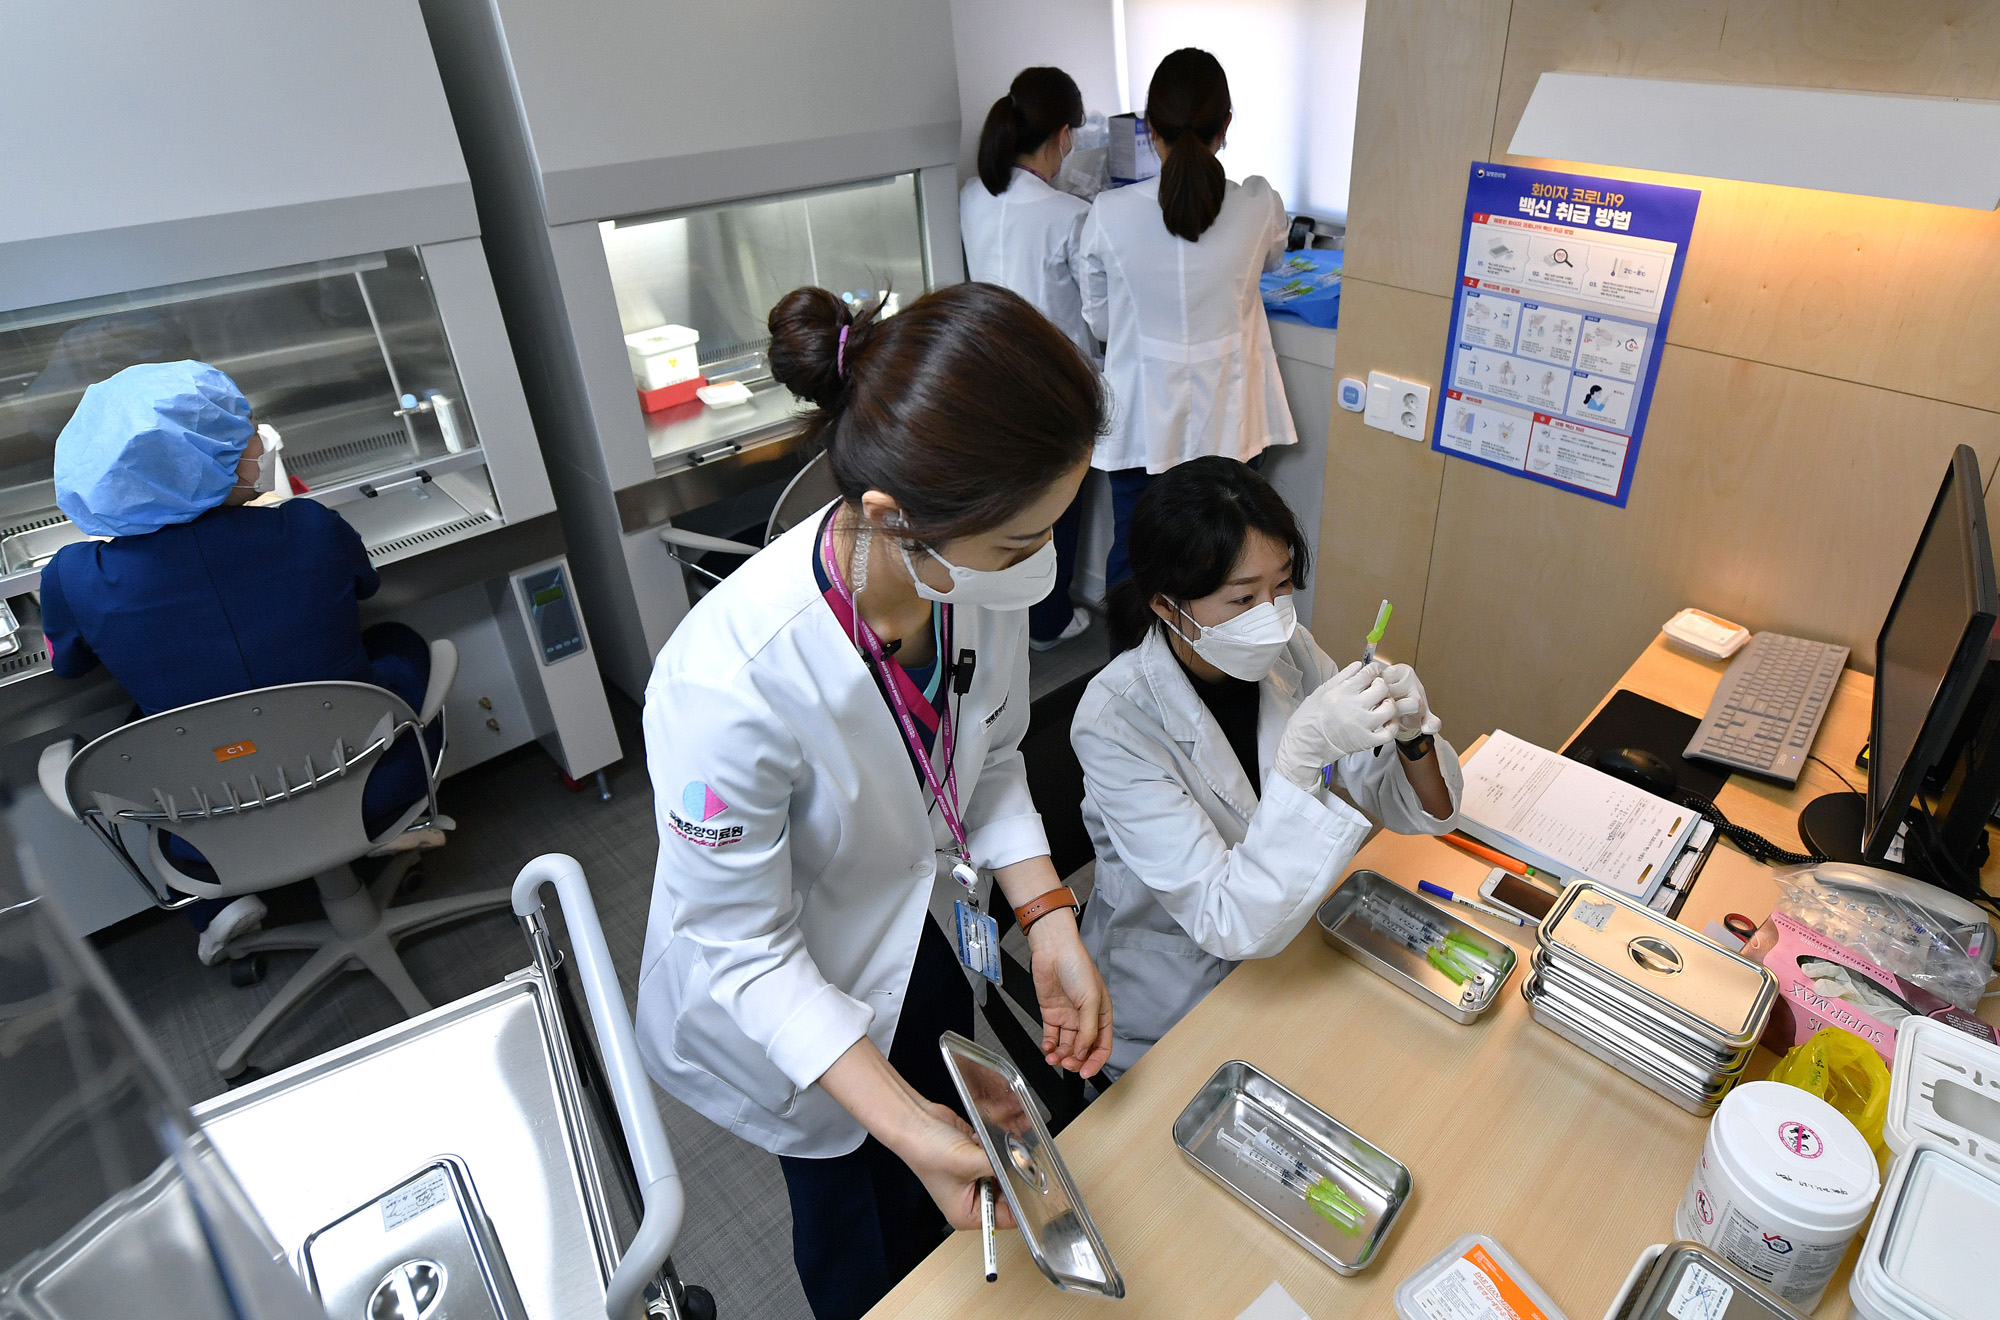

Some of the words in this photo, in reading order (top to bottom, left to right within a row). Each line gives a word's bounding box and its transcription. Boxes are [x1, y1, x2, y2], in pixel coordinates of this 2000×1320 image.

[1531, 183, 1568, 200] 화이자
[1572, 188, 1624, 208] 코로나19
[1519, 196, 1552, 219] 백신
[1555, 202, 1591, 225] 취급
[1594, 207, 1632, 231] 방법
[226, 745, 245, 755] C1
[688, 836, 716, 848] medical
[717, 838, 742, 847] center
[1798, 931, 1840, 955] Examination
[1842, 954, 1871, 971] Medical
[1787, 983, 1886, 1045] SUPERMAX
[1474, 1271, 1489, 1284] DAE
[1487, 1285, 1501, 1298] HAN
